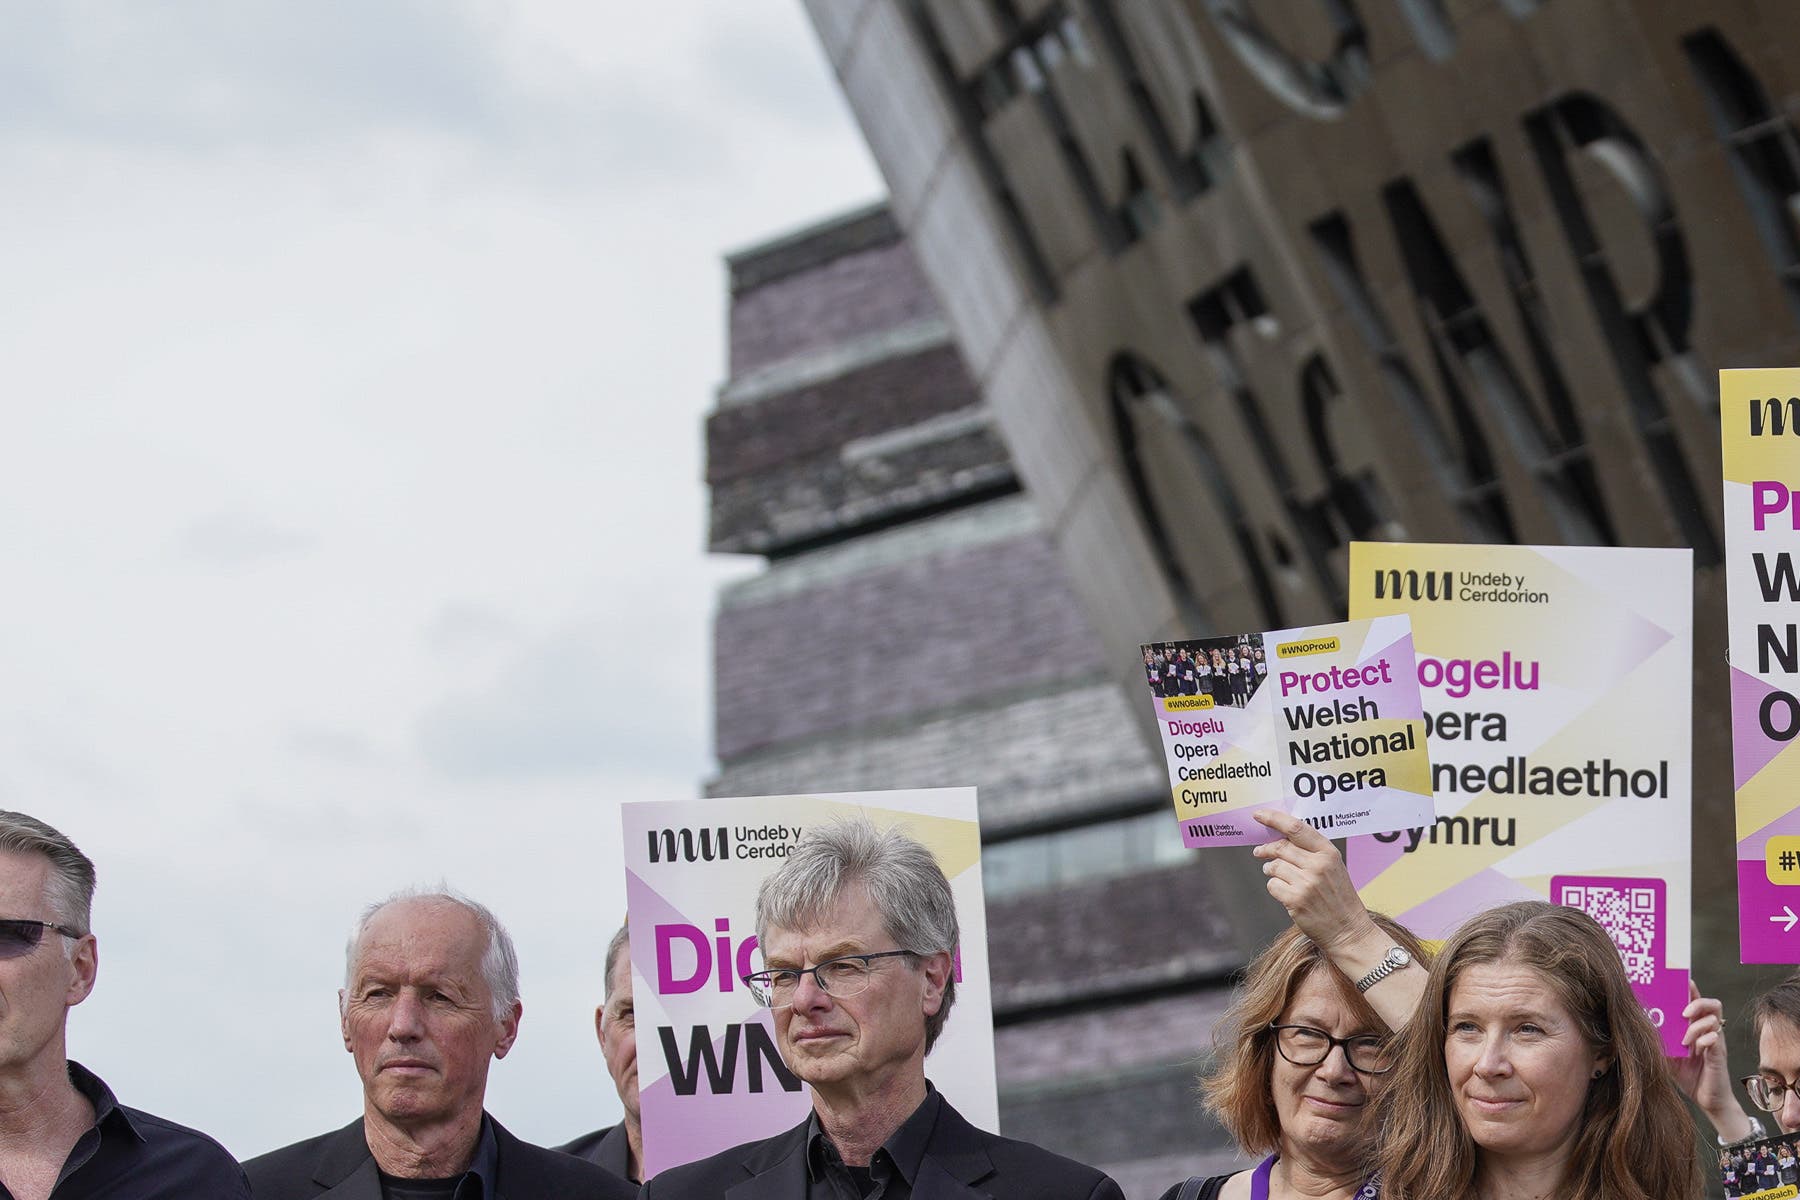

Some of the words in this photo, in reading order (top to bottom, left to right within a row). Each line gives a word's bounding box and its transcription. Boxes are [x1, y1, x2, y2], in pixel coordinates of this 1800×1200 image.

[1460, 571, 1513, 588] Undeb
[1515, 574, 1525, 591] y
[1459, 586, 1549, 604] Cerddorion
[1281, 641, 1335, 655] #WNOProud
[1280, 659, 1391, 697] Protect
[1417, 651, 1539, 698] ogelu
[1283, 695, 1379, 730] Welsh
[1168, 717, 1225, 737] Diogelu
[1174, 743, 1219, 762] Opera
[1289, 725, 1415, 766] National
[1178, 761, 1272, 782] Cenedlaethol
[1432, 757, 1668, 799] nedlaethol
[1294, 768, 1387, 801] Opera
[1182, 789, 1228, 808] Cymru
[1336, 819, 1357, 827] Union
[735, 825, 788, 841] Undeb
[792, 827, 802, 843] y
[657, 1022, 803, 1096] WN
